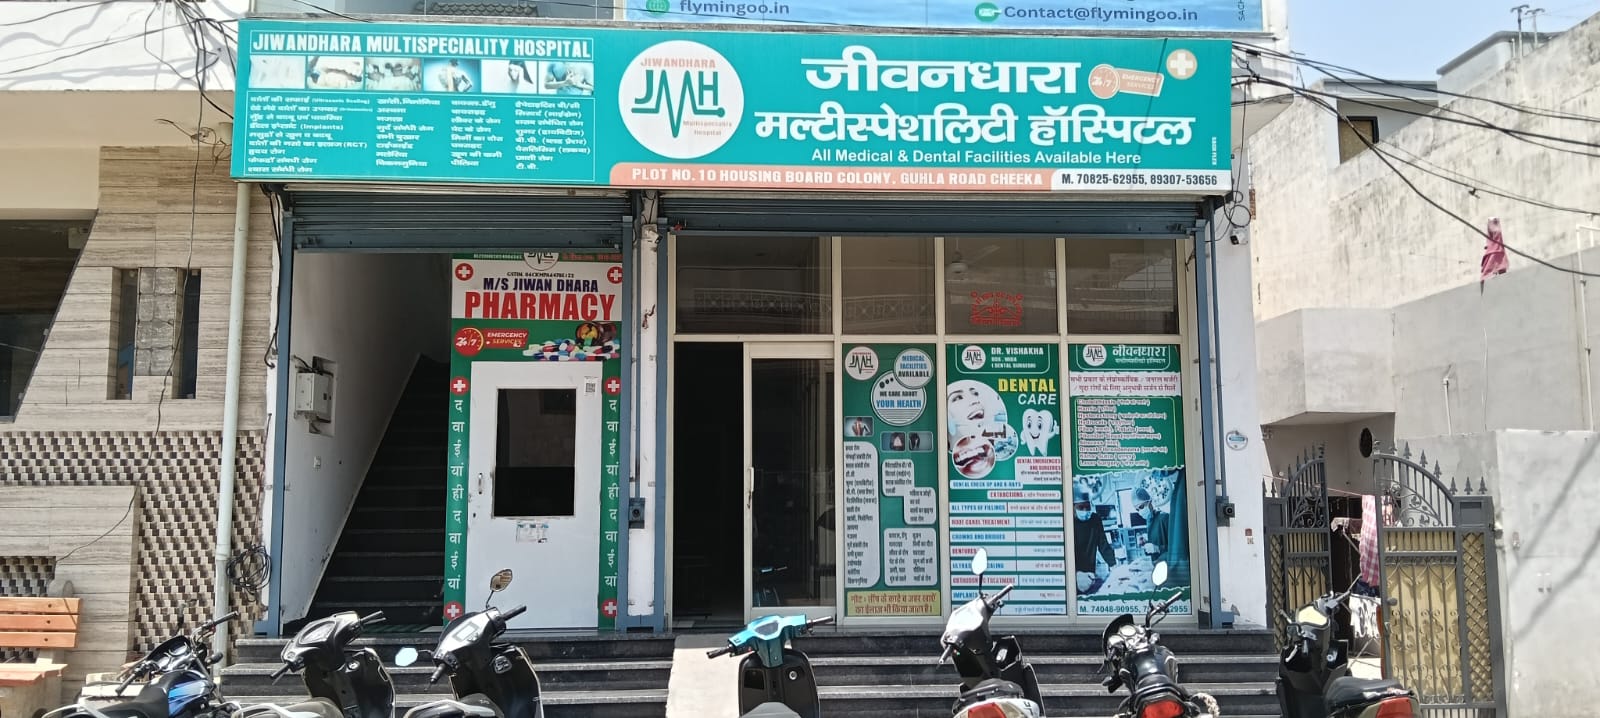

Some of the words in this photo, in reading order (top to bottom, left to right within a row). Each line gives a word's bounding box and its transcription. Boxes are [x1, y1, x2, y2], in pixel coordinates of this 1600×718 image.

[680, 0, 790, 15] flymingoo.in
[1004, 6, 1198, 23] Contact@flymingoo.in
[253, 34, 361, 52] JIWANDHARA
[367, 35, 509, 56] MULTISPECIALITY
[514, 38, 591, 58] HOSPITAL
[641, 57, 716, 68] JIWANDHARA
[801, 45, 1081, 94] जीवनधारा
[754, 101, 1018, 146] मल्टीस्पेशलिटी
[1029, 104, 1196, 146] हॉस्पिटल
[812, 149, 831, 162] All
[835, 149, 893, 163] Medical
[898, 150, 909, 163] &
[913, 150, 961, 163] Dental
[965, 150, 1030, 163] Facilities
[1035, 151, 1101, 164] Available
[1106, 151, 1141, 165] Here
[632, 168, 668, 181] PLOT
[672, 168, 696, 181] NO.
[700, 168, 716, 181] 10
[720, 170, 781, 183] HOUSING
[785, 171, 833, 184] BOARD
[901, 173, 945, 185] GUHLA
[950, 173, 986, 185] ROAD
[990, 174, 1043, 186] CHEEKA
[1062, 173, 1074, 185] M.
[1077, 173, 1147, 186] 70825-62955,
[1150, 174, 1217, 187] 89307-53656
[483, 278, 509, 291] M/S
[513, 278, 551, 292] JIWAN
[557, 279, 599, 293] DHARA
[465, 291, 615, 321] PHARMACY
[991, 347, 1004, 355] DR.
[1006, 347, 1044, 355] VISHAKHA
[998, 378, 1057, 392] DENTAL
[877, 400, 895, 408] YOUR
[1018, 394, 1057, 405] CARE
